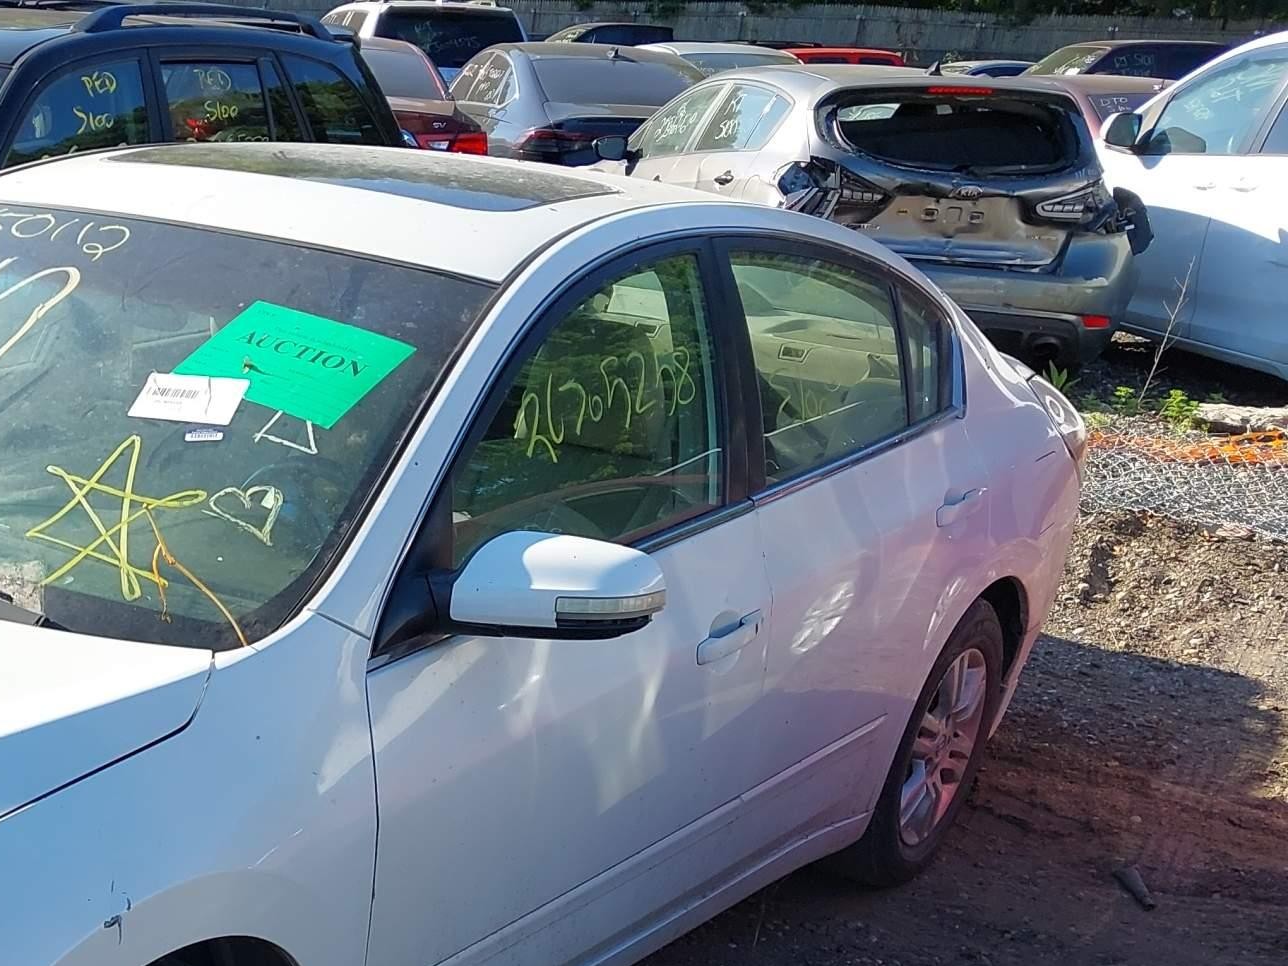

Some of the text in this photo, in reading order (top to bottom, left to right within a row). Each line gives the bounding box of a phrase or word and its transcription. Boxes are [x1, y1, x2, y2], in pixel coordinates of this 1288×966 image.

[81, 71, 117, 98] PED
[192, 68, 232, 91] PED
[432, 121, 447, 129] SV
[960, 188, 980, 198] KIA
[236, 330, 370, 377] AUCTION
